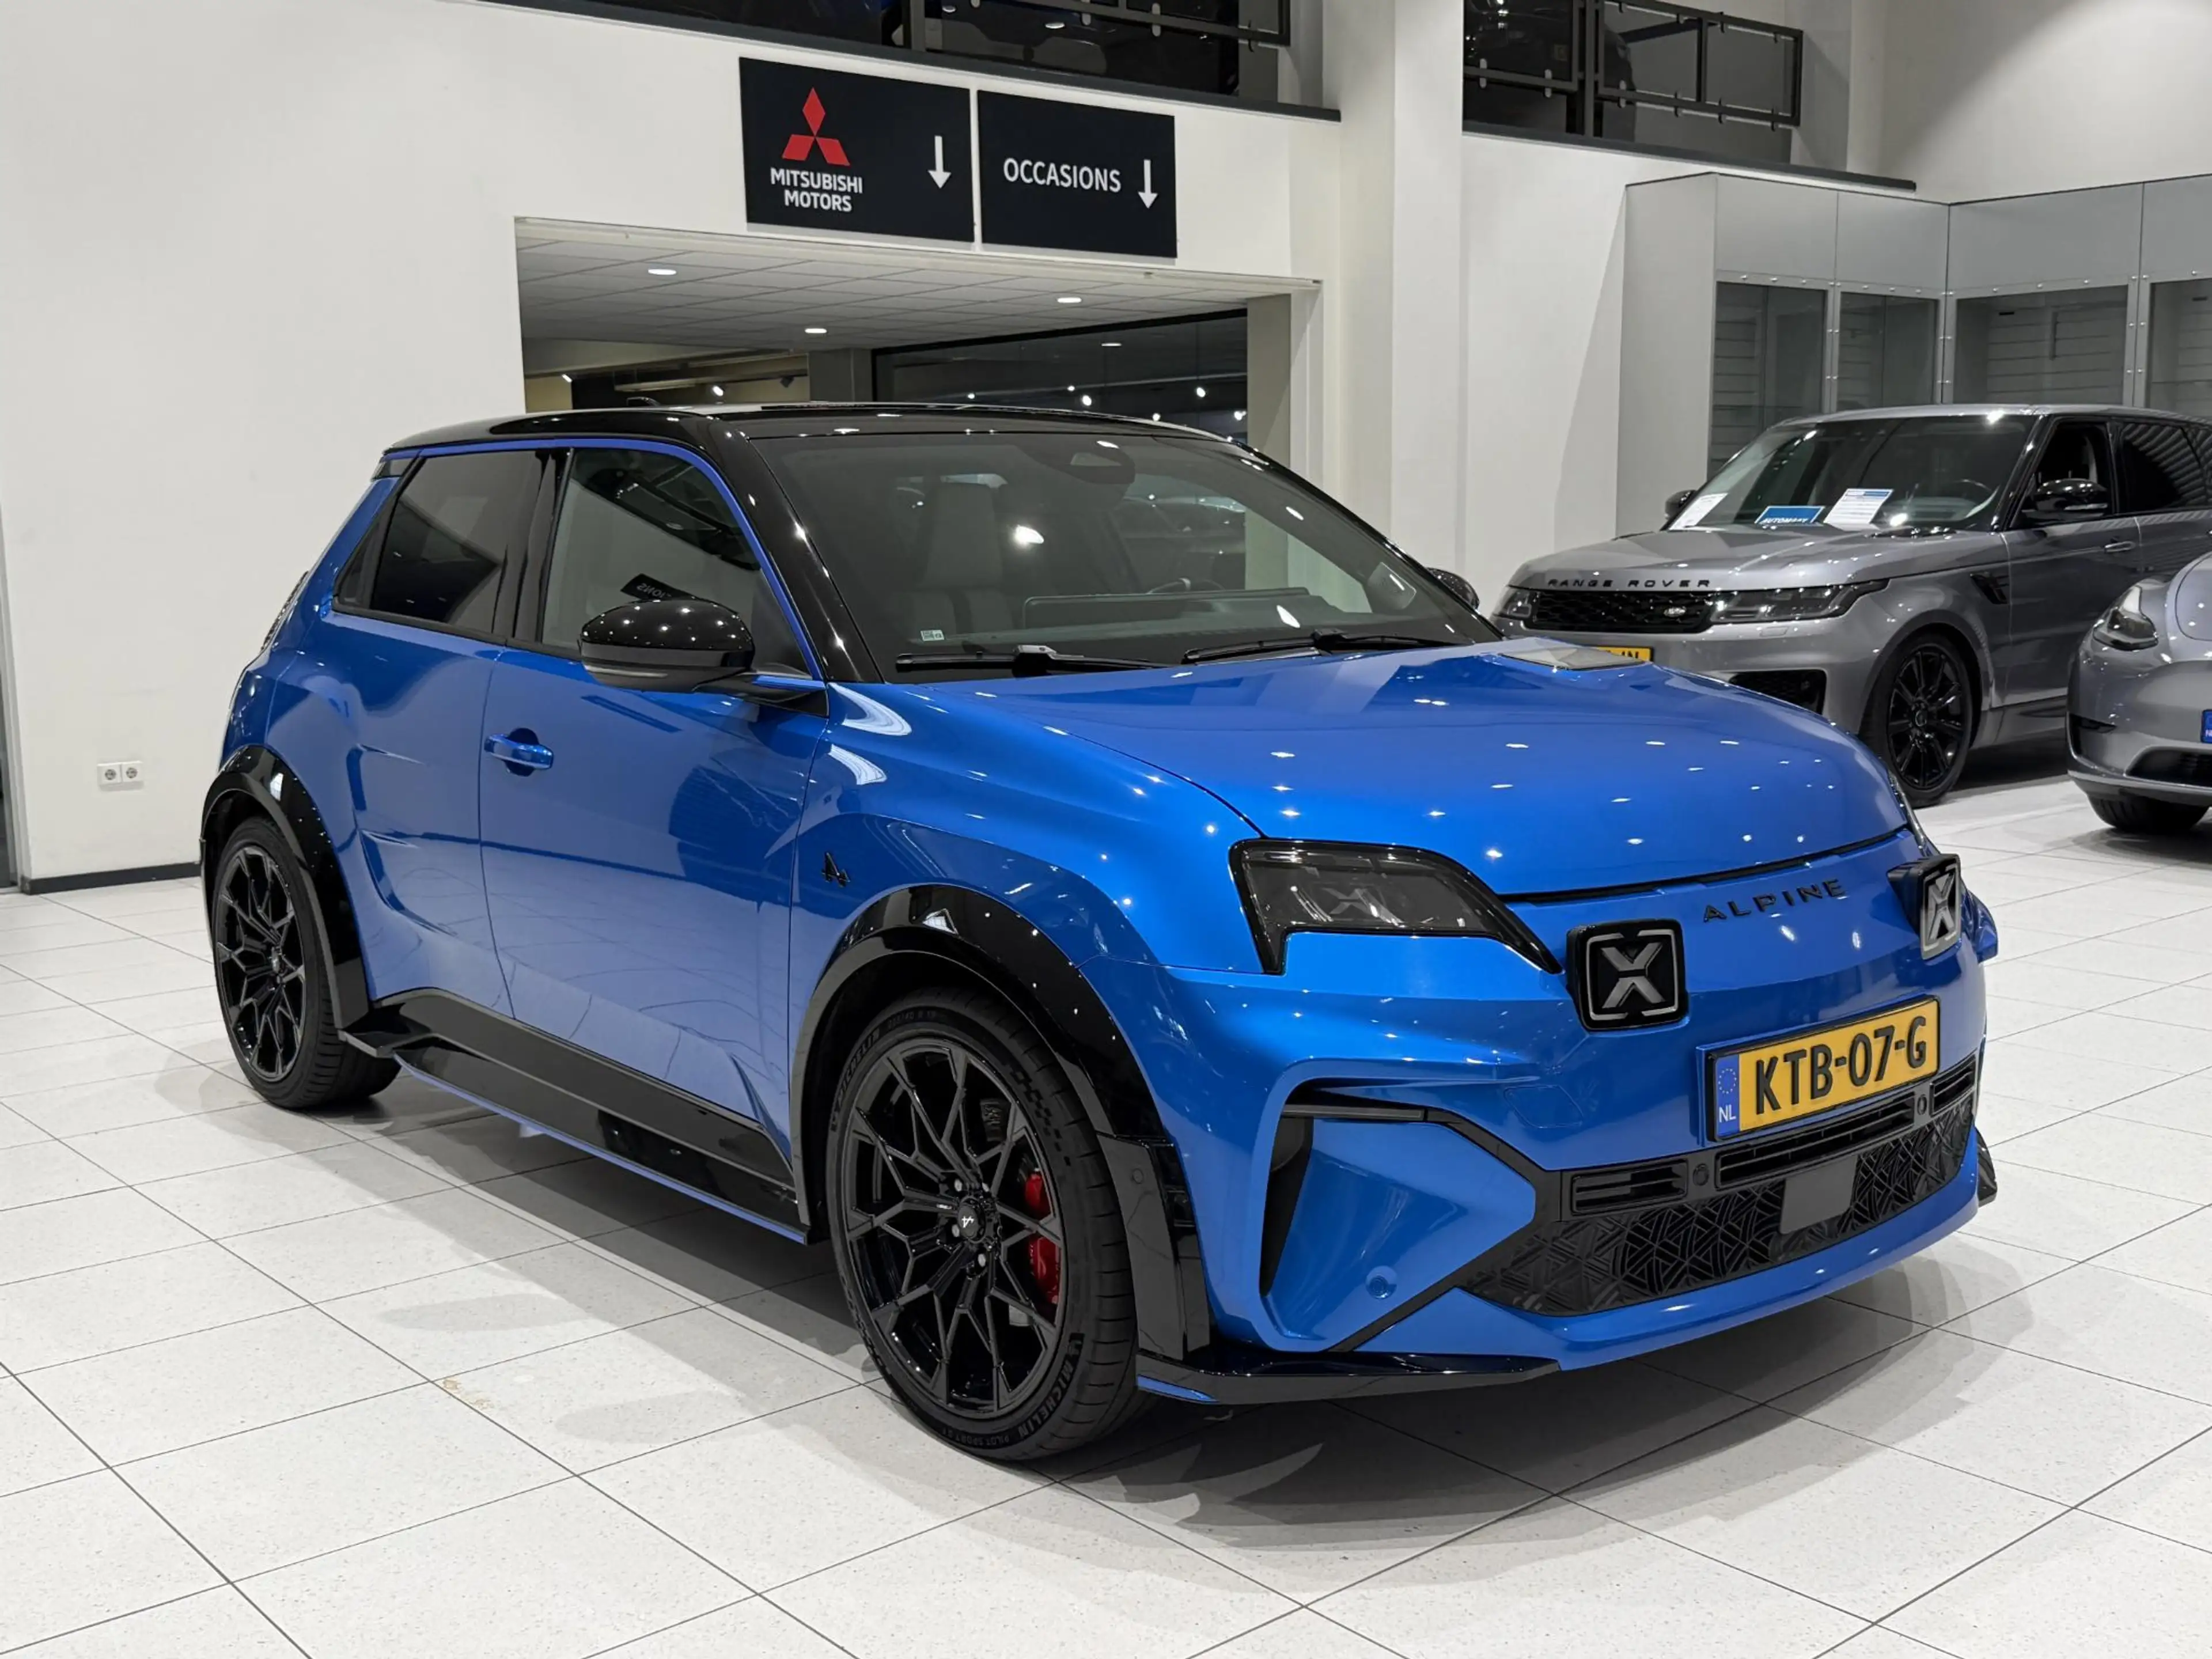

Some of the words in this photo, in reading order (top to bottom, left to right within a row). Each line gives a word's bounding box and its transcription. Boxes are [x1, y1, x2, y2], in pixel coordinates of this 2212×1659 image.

[770, 167, 863, 194] MITSUBISHI
[1003, 157, 1121, 192] OCCASIONS
[784, 190, 852, 212] MOTORS
[1547, 578, 1613, 588] RANGE
[1627, 579, 1711, 588] ROVER
[1703, 878, 1846, 923] ALPINE
[1756, 1016, 1927, 1115] KTB-07-G
[1718, 1104, 1737, 1123] NL
[1018, 1359, 1074, 1439] MICHELIN
